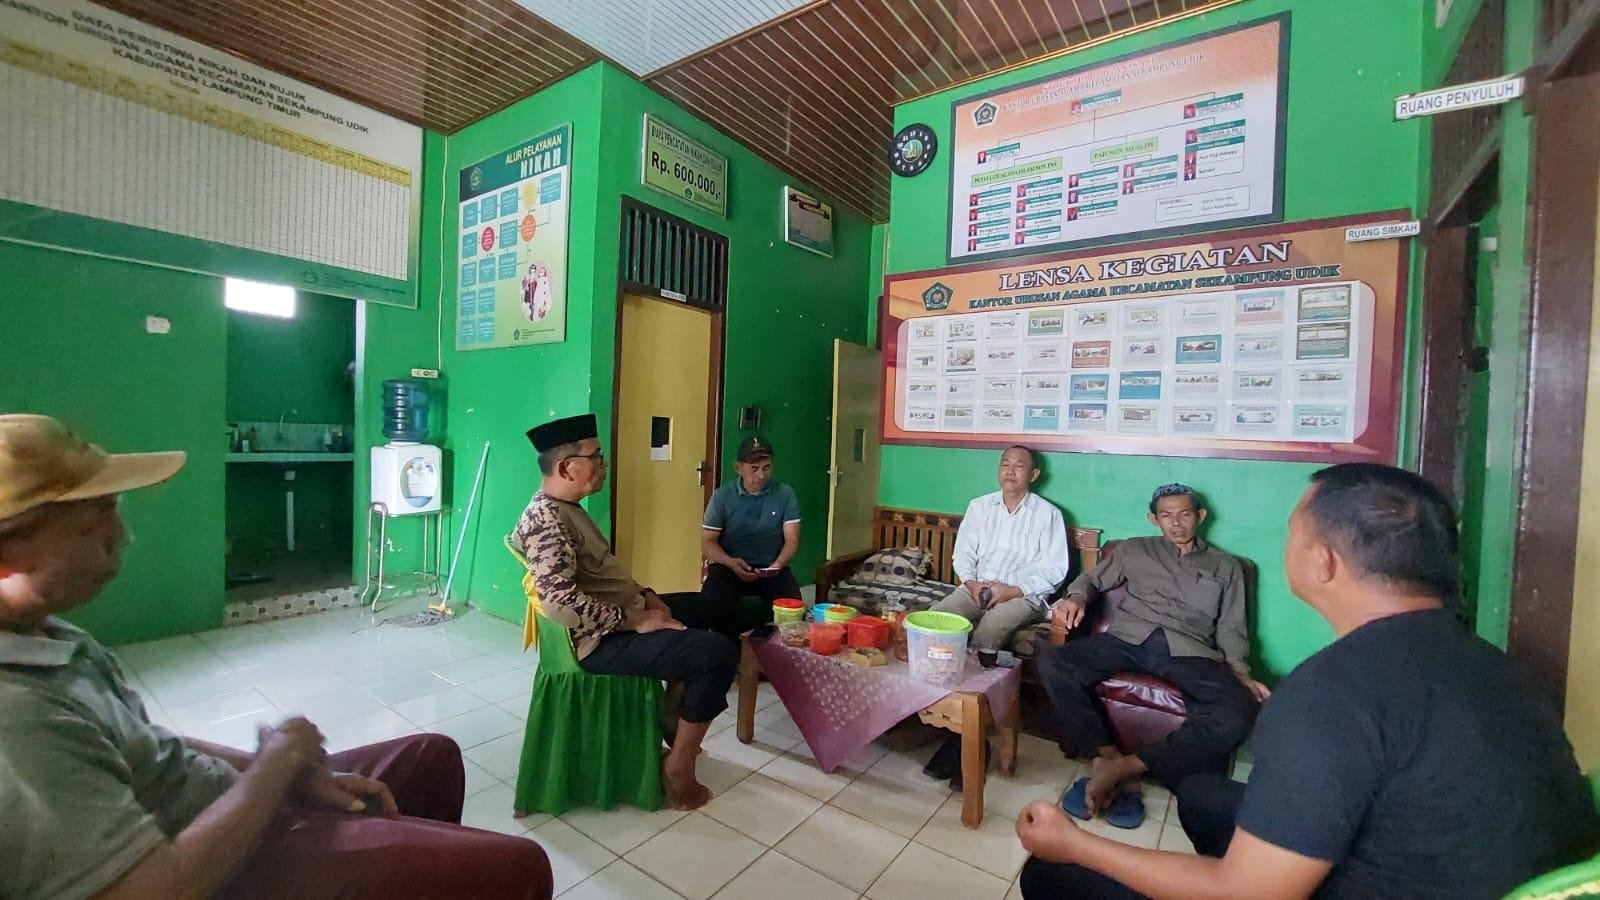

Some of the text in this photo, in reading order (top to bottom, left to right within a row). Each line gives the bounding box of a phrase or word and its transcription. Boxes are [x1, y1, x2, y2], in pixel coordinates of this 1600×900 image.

[72, 10, 114, 32] DATA
[199, 57, 238, 77] NIKAH
[241, 72, 266, 87] DAN
[269, 83, 306, 102] RUJUK
[113, 48, 301, 119] KABUPATEN LAMPUNG TIMUR
[144, 48, 195, 72] AGAMA
[199, 68, 275, 100] KECAMATAN
[277, 95, 344, 125] SEKAMPUNG
[346, 120, 370, 134] UDIK
[1400, 83, 1514, 113] RUANG PENYULUH
[506, 134, 562, 165] ALUR PELAYANAN
[520, 148, 561, 178] NIKAH
[652, 151, 670, 174] Rp.
[1348, 224, 1417, 238] RUANG SIMKAH
[999, 240, 1292, 292] LENSA KEGIATAN
[969, 265, 1341, 309] KANTOR URUSAN AGAMA KECAMATAN SEKAMPUNG UDIK
